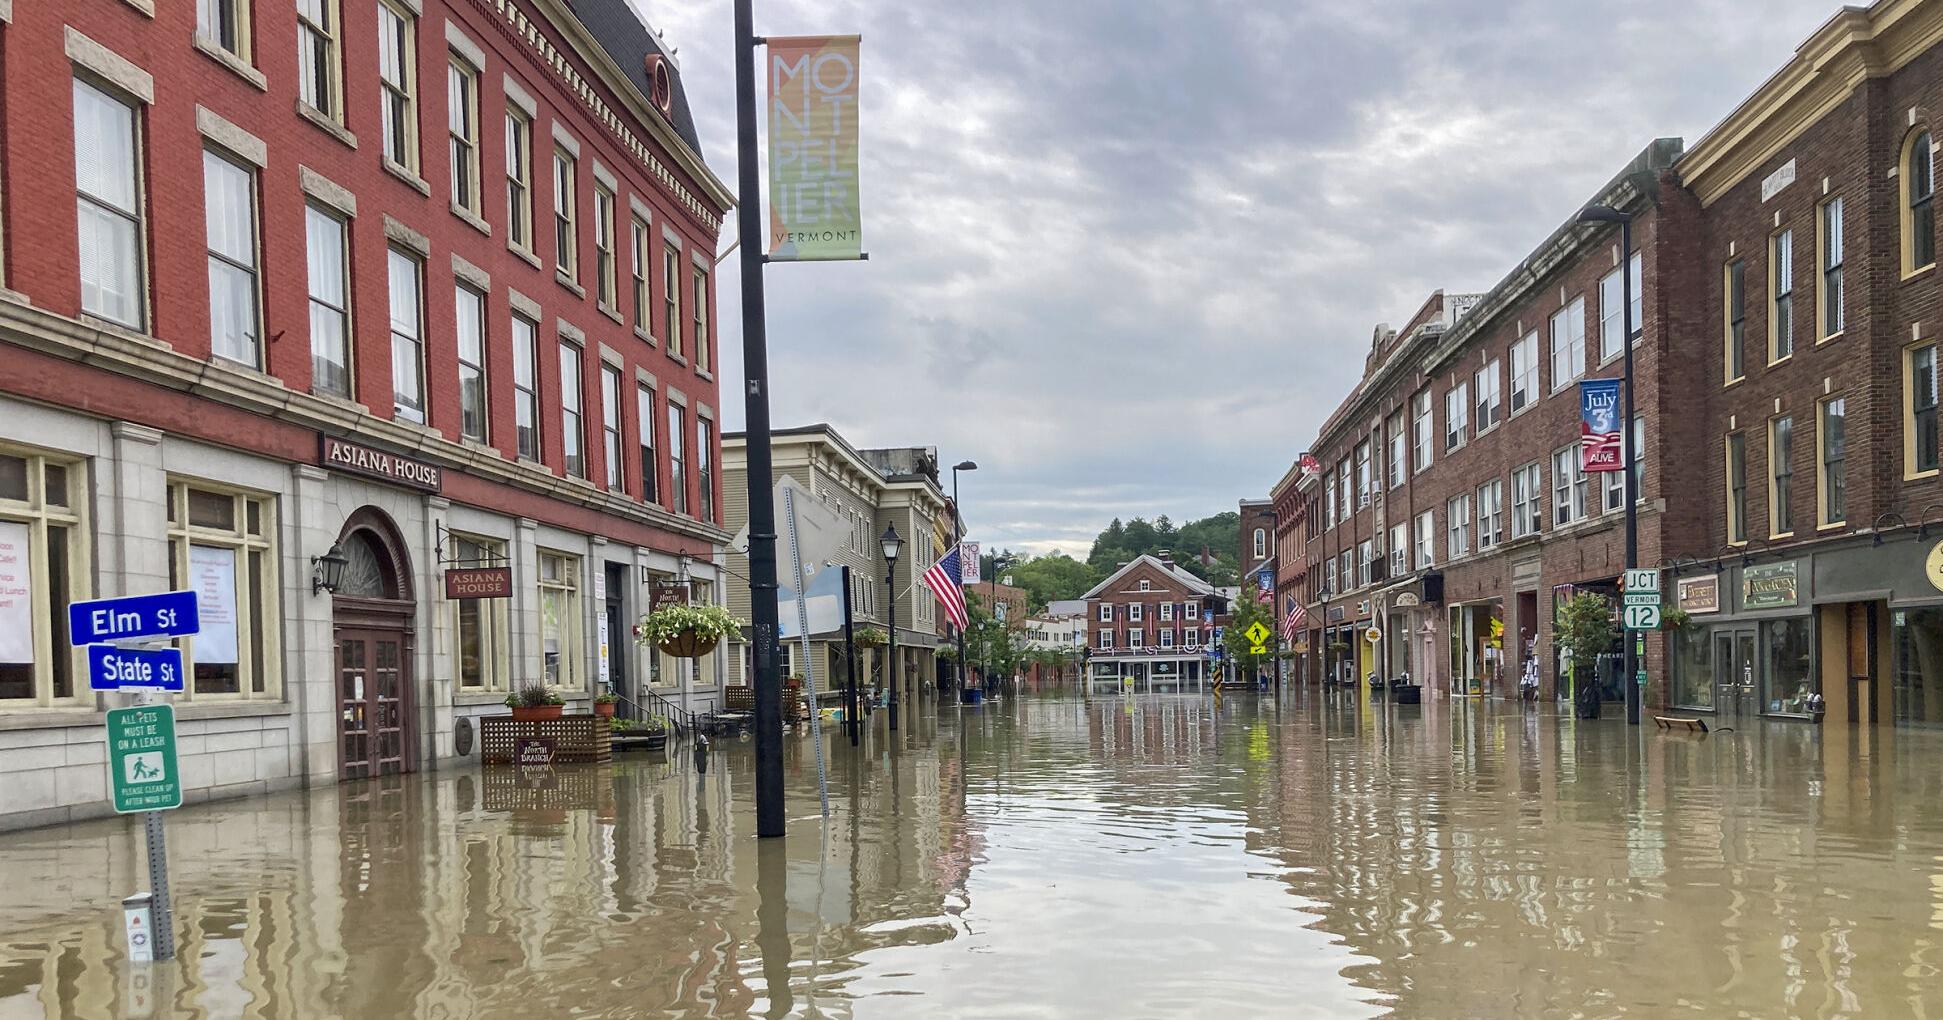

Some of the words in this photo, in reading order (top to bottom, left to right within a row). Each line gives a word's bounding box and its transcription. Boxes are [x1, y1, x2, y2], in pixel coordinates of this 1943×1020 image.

[776, 231, 857, 243] VERMONT
[1585, 392, 1617, 412] July
[330, 442, 391, 473] ASIANA
[395, 458, 438, 485] HOUSE
[1590, 453, 1614, 463] ALIVE
[452, 572, 505, 584] ASIANA
[1629, 573, 1656, 588] JCT
[456, 582, 502, 594] HOUSE
[1626, 595, 1659, 604] VERMONT
[92, 608, 142, 635] Elm
[157, 608, 178, 628] St
[1631, 606, 1654, 627] 12
[103, 654, 152, 681] State
[161, 663, 175, 682] St
[121, 714, 137, 725] ALL
[124, 725, 145, 737] MUST
[147, 724, 157, 735] BE
[118, 740, 129, 750] ON
[132, 739, 138, 748] A
[140, 736, 166, 748] LEASH
[524, 746, 547, 754] NORTH
[521, 753, 549, 762] BRANCH
[121, 787, 144, 796] PLEASE
[144, 785, 164, 794] CLEAN
[165, 783, 174, 792] UP
[125, 798, 143, 806] AFTER
[161, 794, 172, 803] PET
